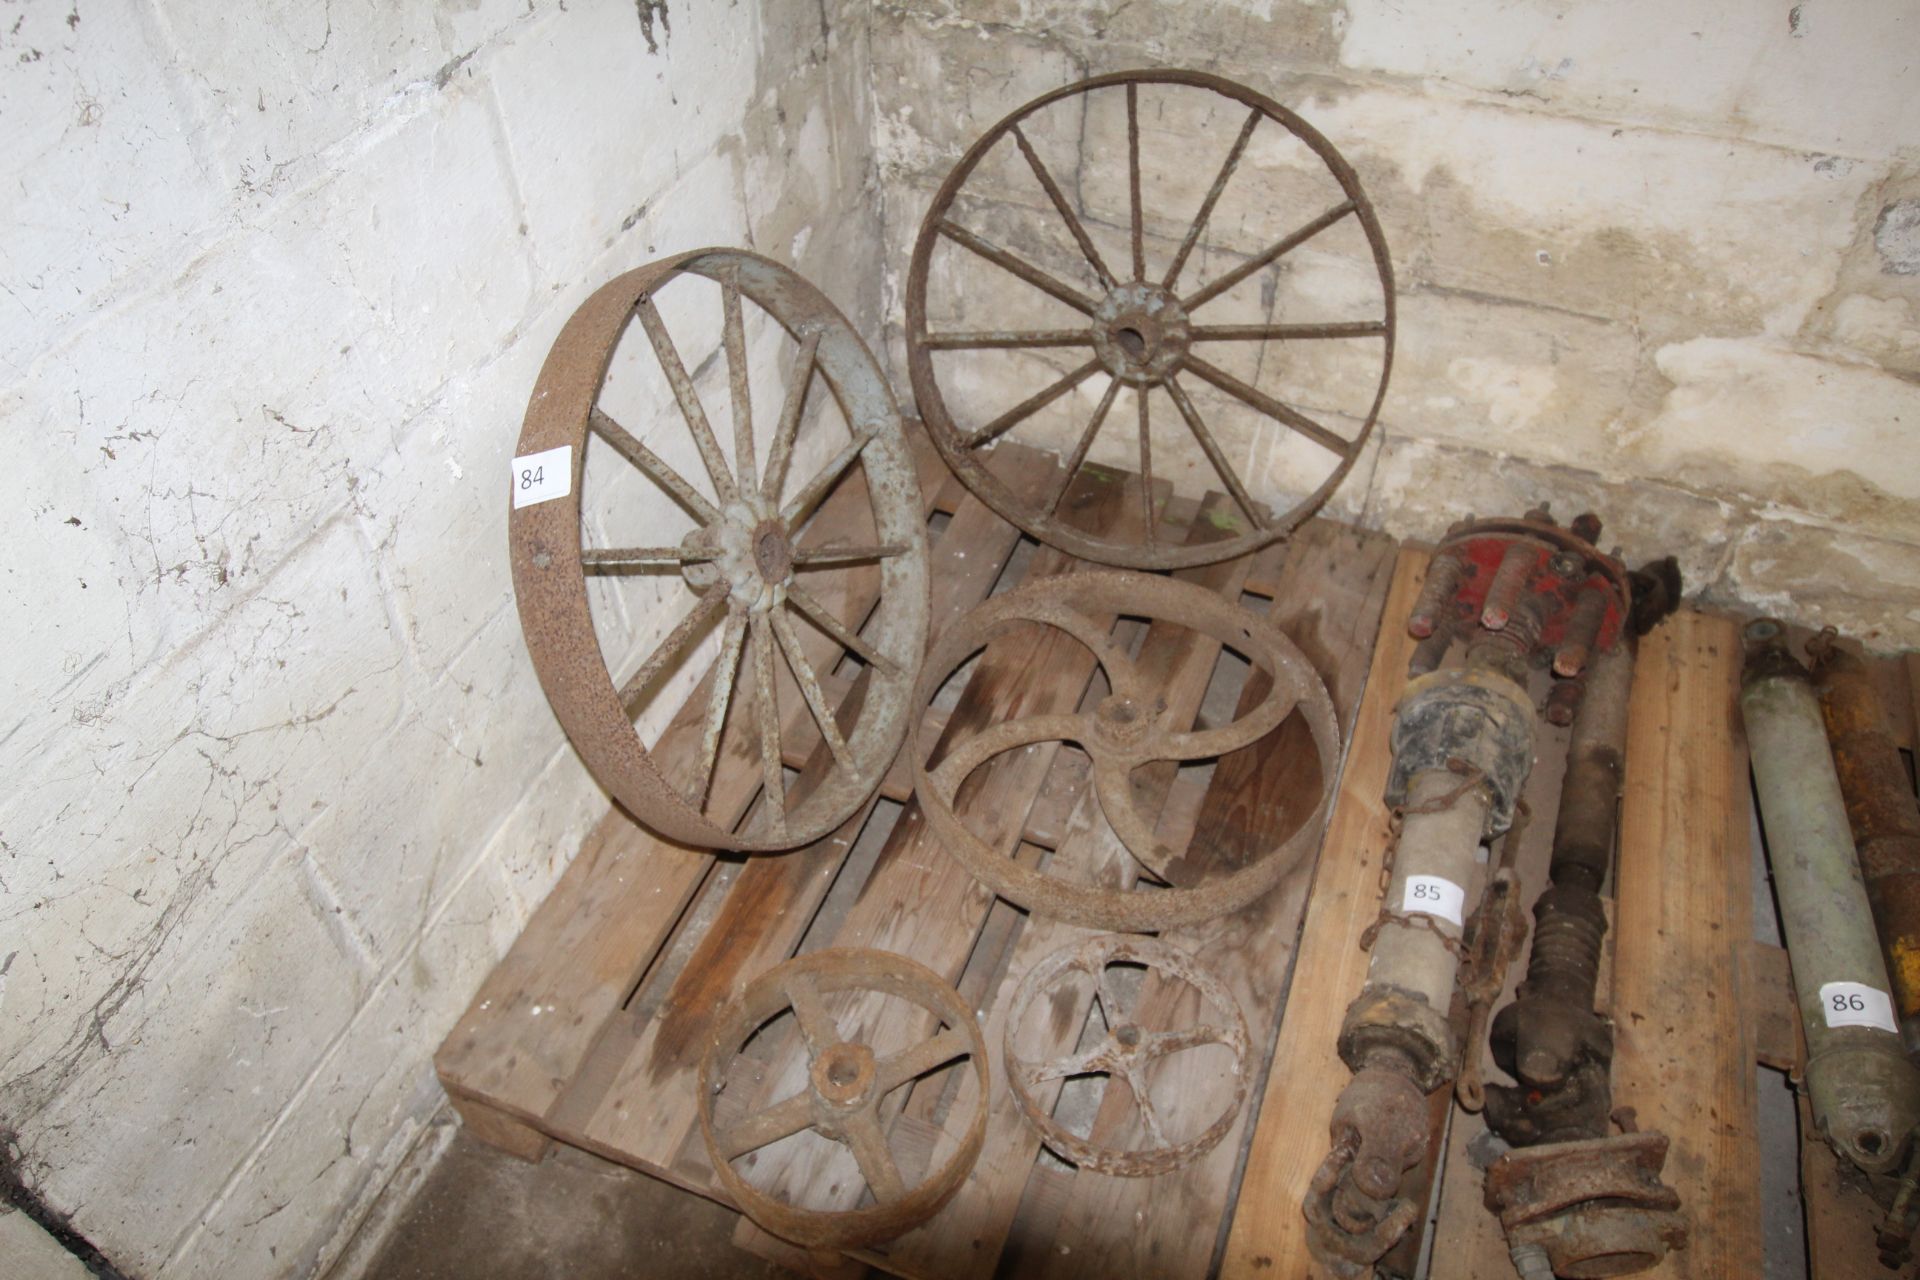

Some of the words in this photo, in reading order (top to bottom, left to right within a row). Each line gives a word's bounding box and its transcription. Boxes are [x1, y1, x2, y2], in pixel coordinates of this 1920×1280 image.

[520, 466, 545, 489] 84
[1413, 884, 1441, 901] 85
[1832, 994, 1865, 1012] 86
